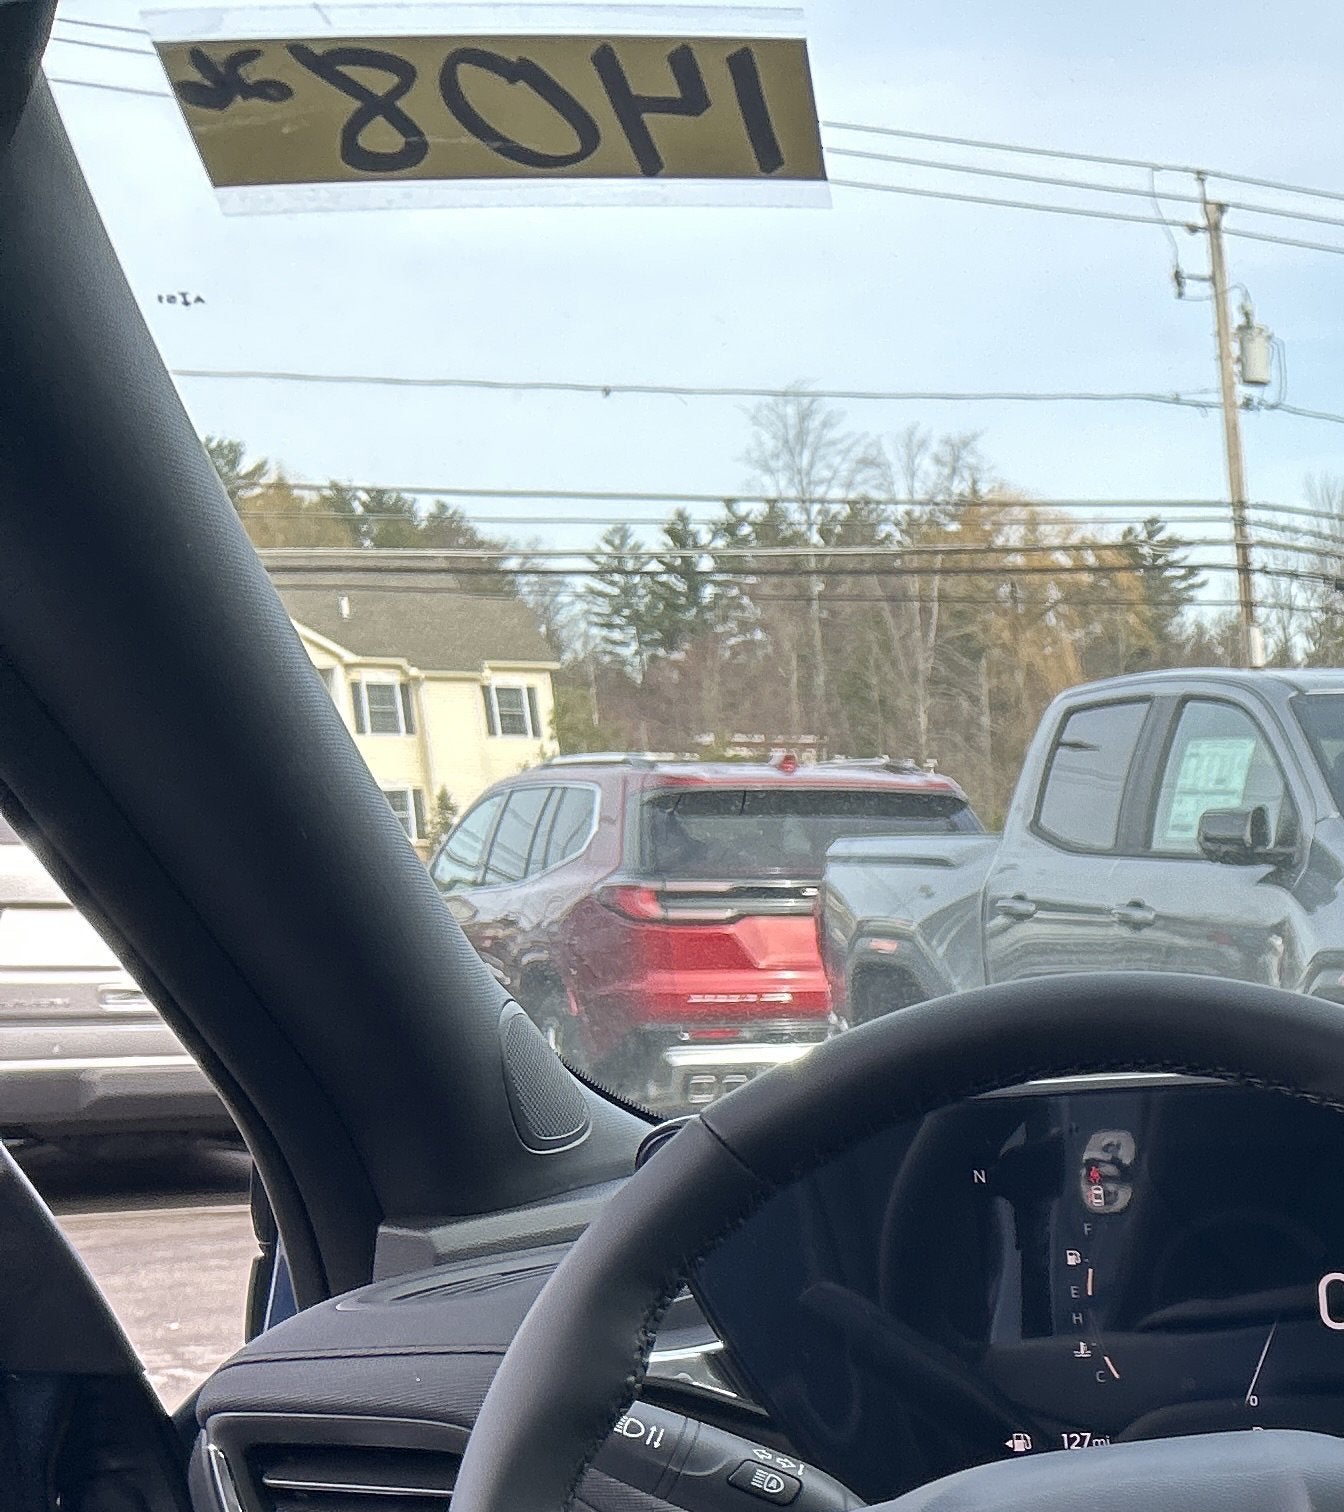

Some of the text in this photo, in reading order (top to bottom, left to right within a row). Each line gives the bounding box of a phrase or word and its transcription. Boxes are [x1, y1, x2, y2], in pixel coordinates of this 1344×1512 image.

[973, 1169, 987, 1184] N
[1084, 1223, 1093, 1235] F
[1070, 1285, 1080, 1298] E
[1072, 1312, 1083, 1324] H
[1095, 1370, 1106, 1383] C
[1249, 1395, 1258, 1407] 0
